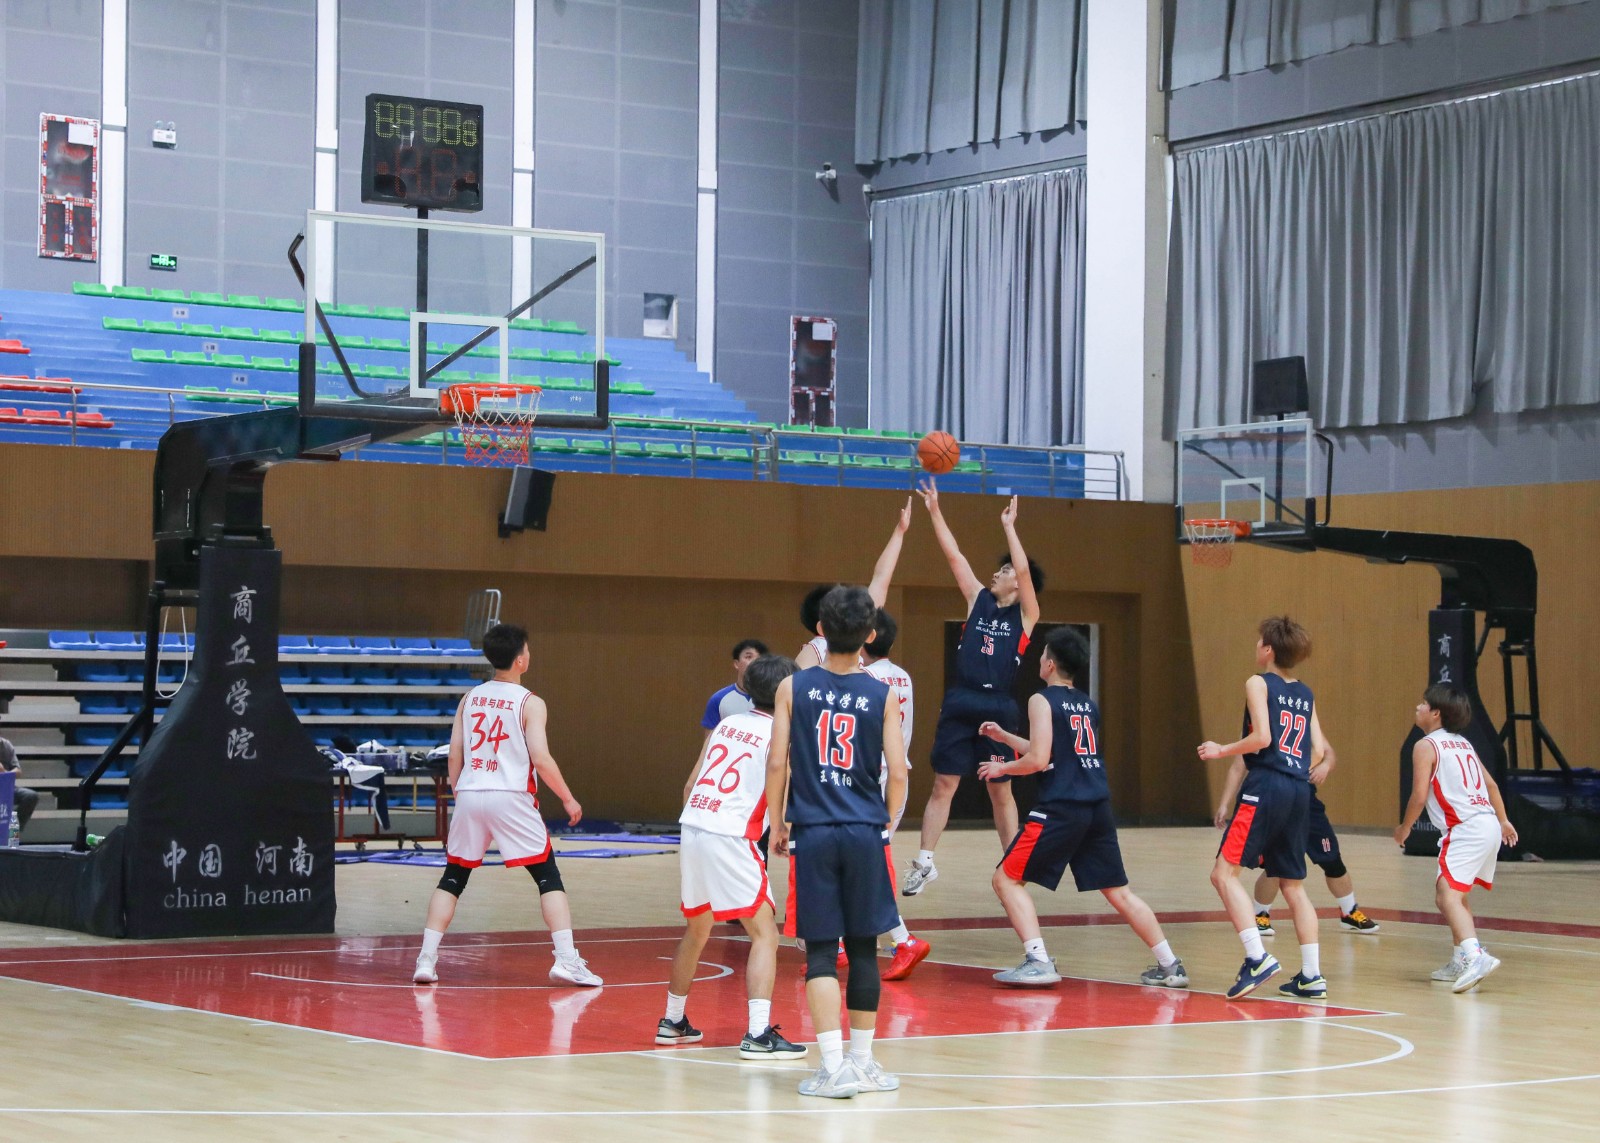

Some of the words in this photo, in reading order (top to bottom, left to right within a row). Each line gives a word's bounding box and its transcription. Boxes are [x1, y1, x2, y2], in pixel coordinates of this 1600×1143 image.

[225, 585, 257, 760] 商丘学院
[1437, 633, 1452, 683] 商丘
[470, 696, 515, 710] 风景与建工
[808, 687, 869, 712] 机电学院
[470, 711, 510, 755] 34
[717, 724, 763, 748] 风景与建工
[816, 709, 856, 770] 13
[1070, 714, 1097, 755] 21
[1278, 710, 1307, 759] 22
[471, 757, 498, 772] 李帅
[696, 743, 753, 794] 26
[1455, 753, 1481, 791] 10
[690, 793, 722, 813] 毛连峰
[162, 839, 223, 884] 中国
[255, 836, 315, 877] 河南
[163, 887, 227, 909] china
[243, 884, 312, 906] henan
